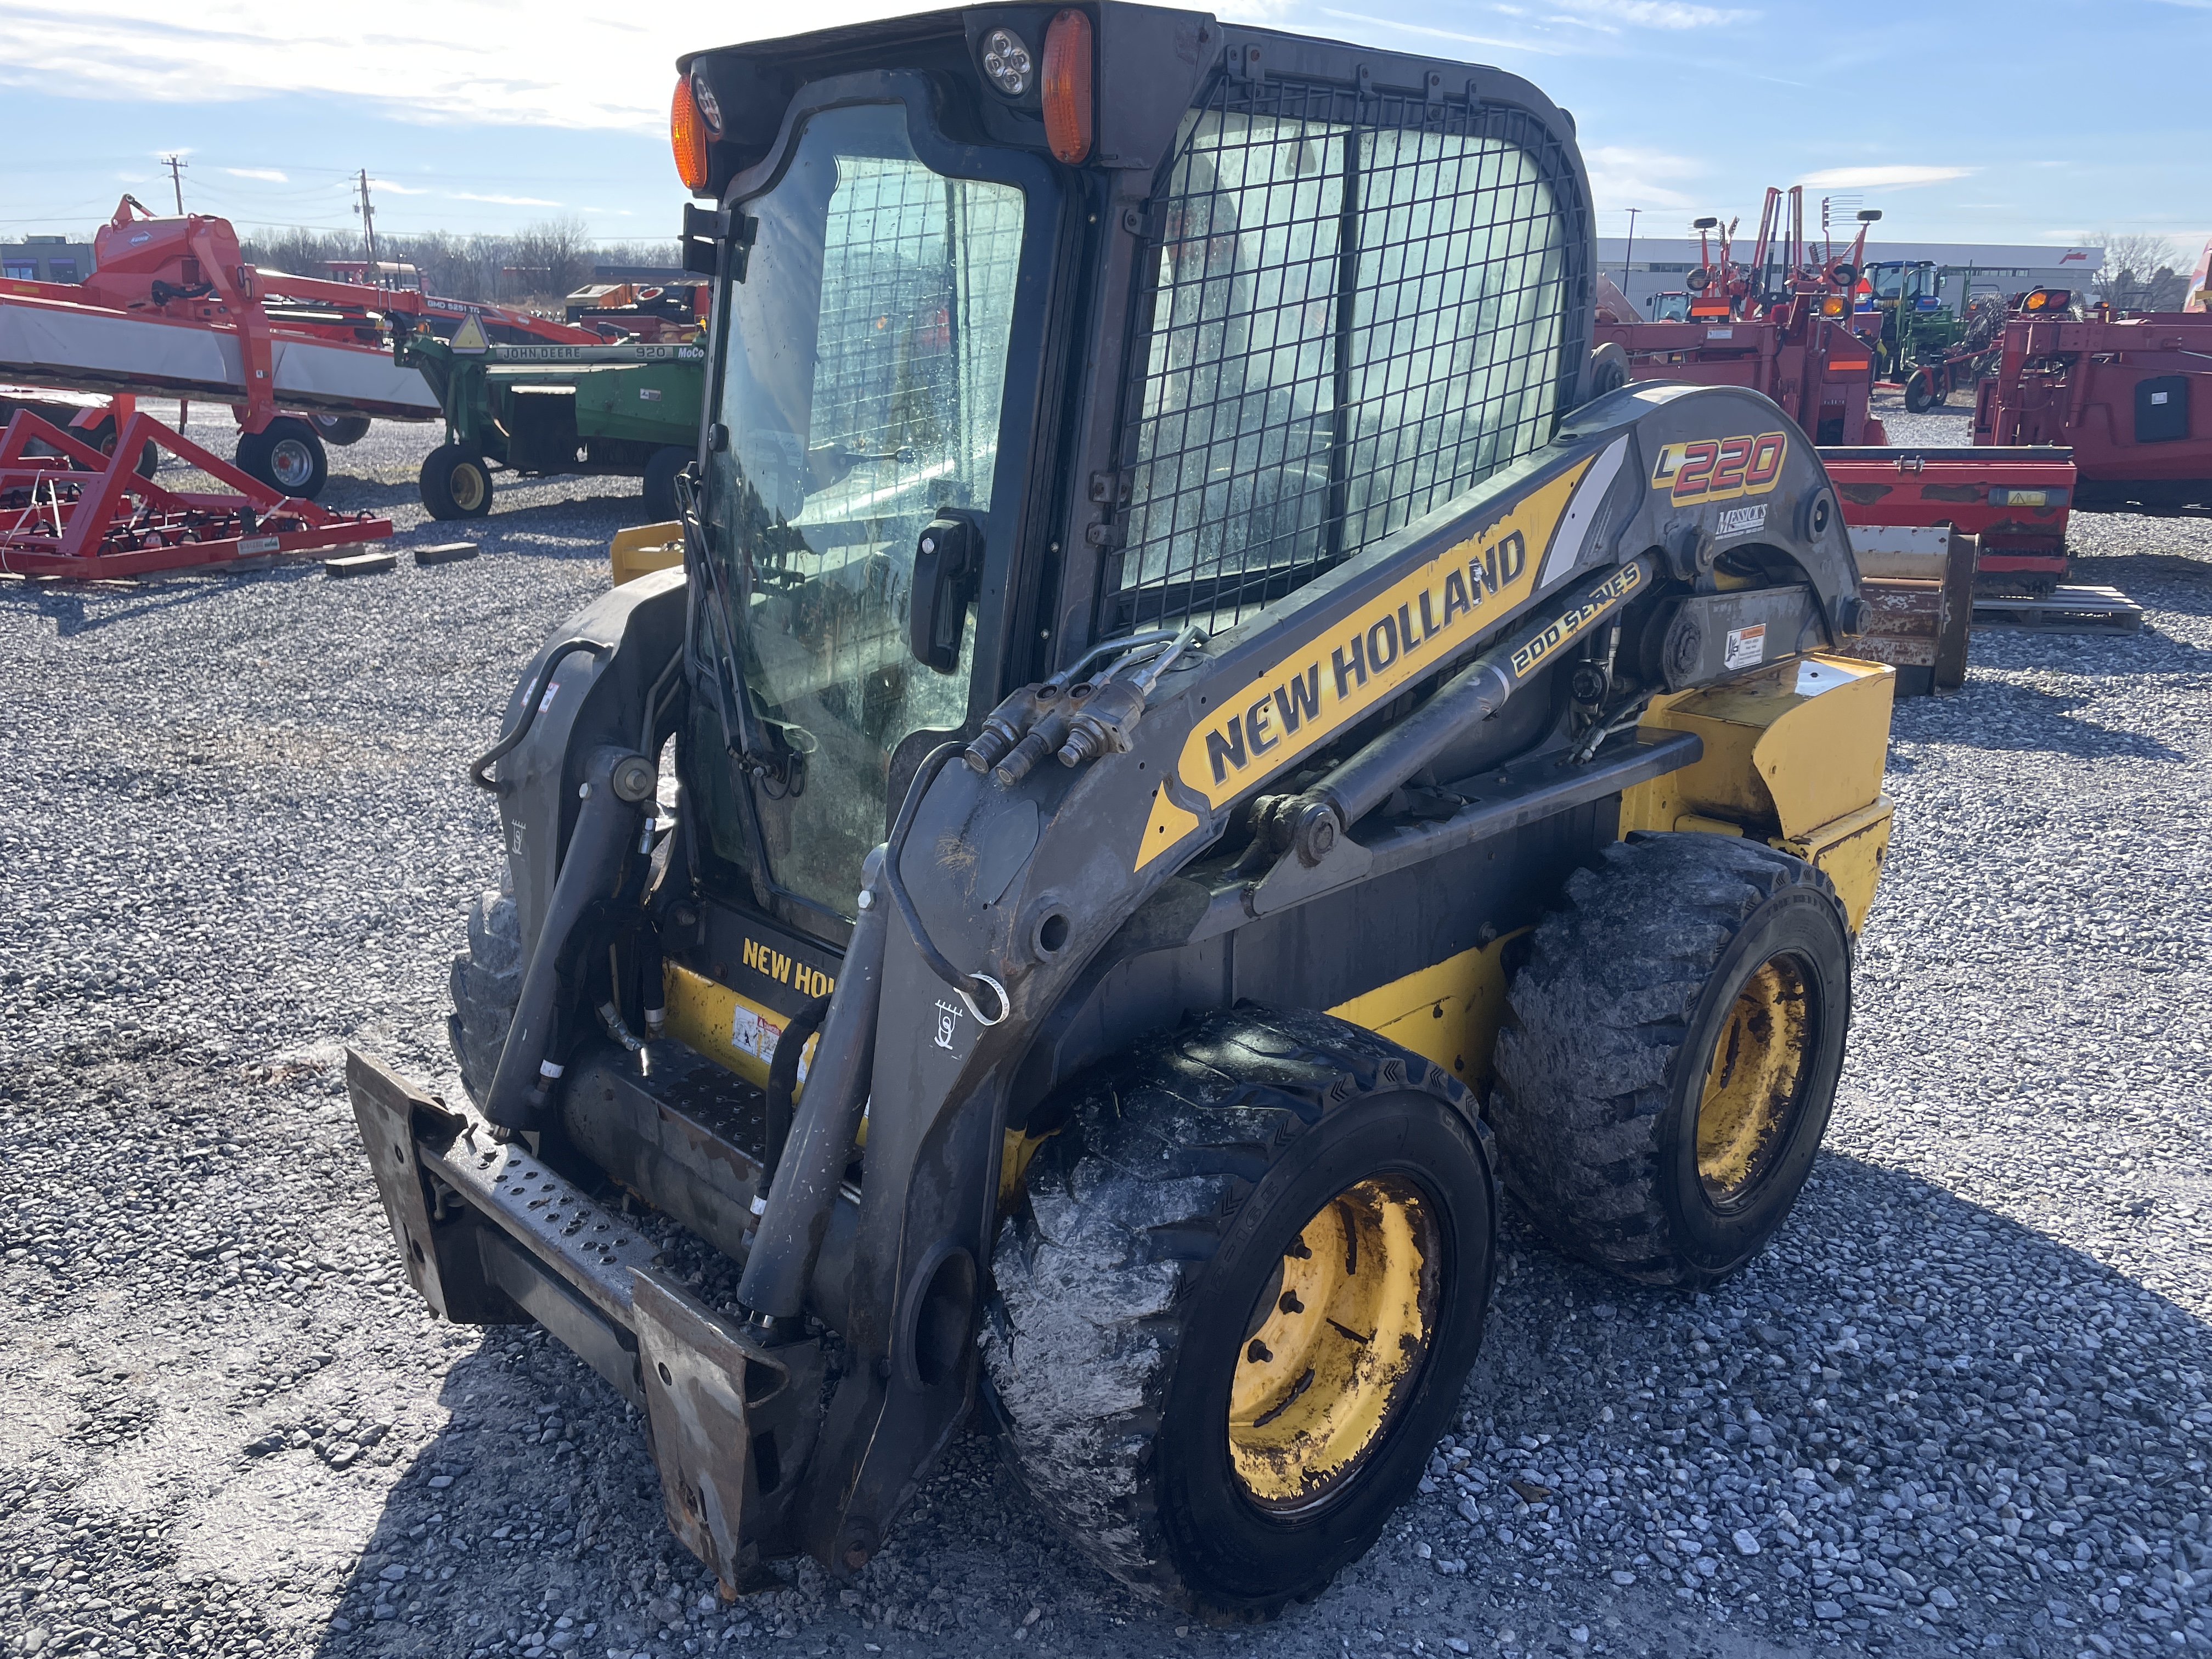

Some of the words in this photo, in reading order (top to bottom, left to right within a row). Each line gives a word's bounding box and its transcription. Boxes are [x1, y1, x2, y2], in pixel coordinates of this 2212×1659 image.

[503, 348, 537, 359] JOHN
[540, 347, 580, 359] DEERE
[636, 347, 665, 358] 920
[678, 347, 704, 358] MoCo
[1652, 432, 1786, 501] L220
[1715, 504, 1768, 535] MESSICK'S
[1514, 630, 1561, 673] 200
[1564, 563, 1638, 633] SERIES
[1205, 661, 1320, 786] NEW
[1331, 529, 1526, 700] HOLLAND
[743, 937, 791, 984] NEW
